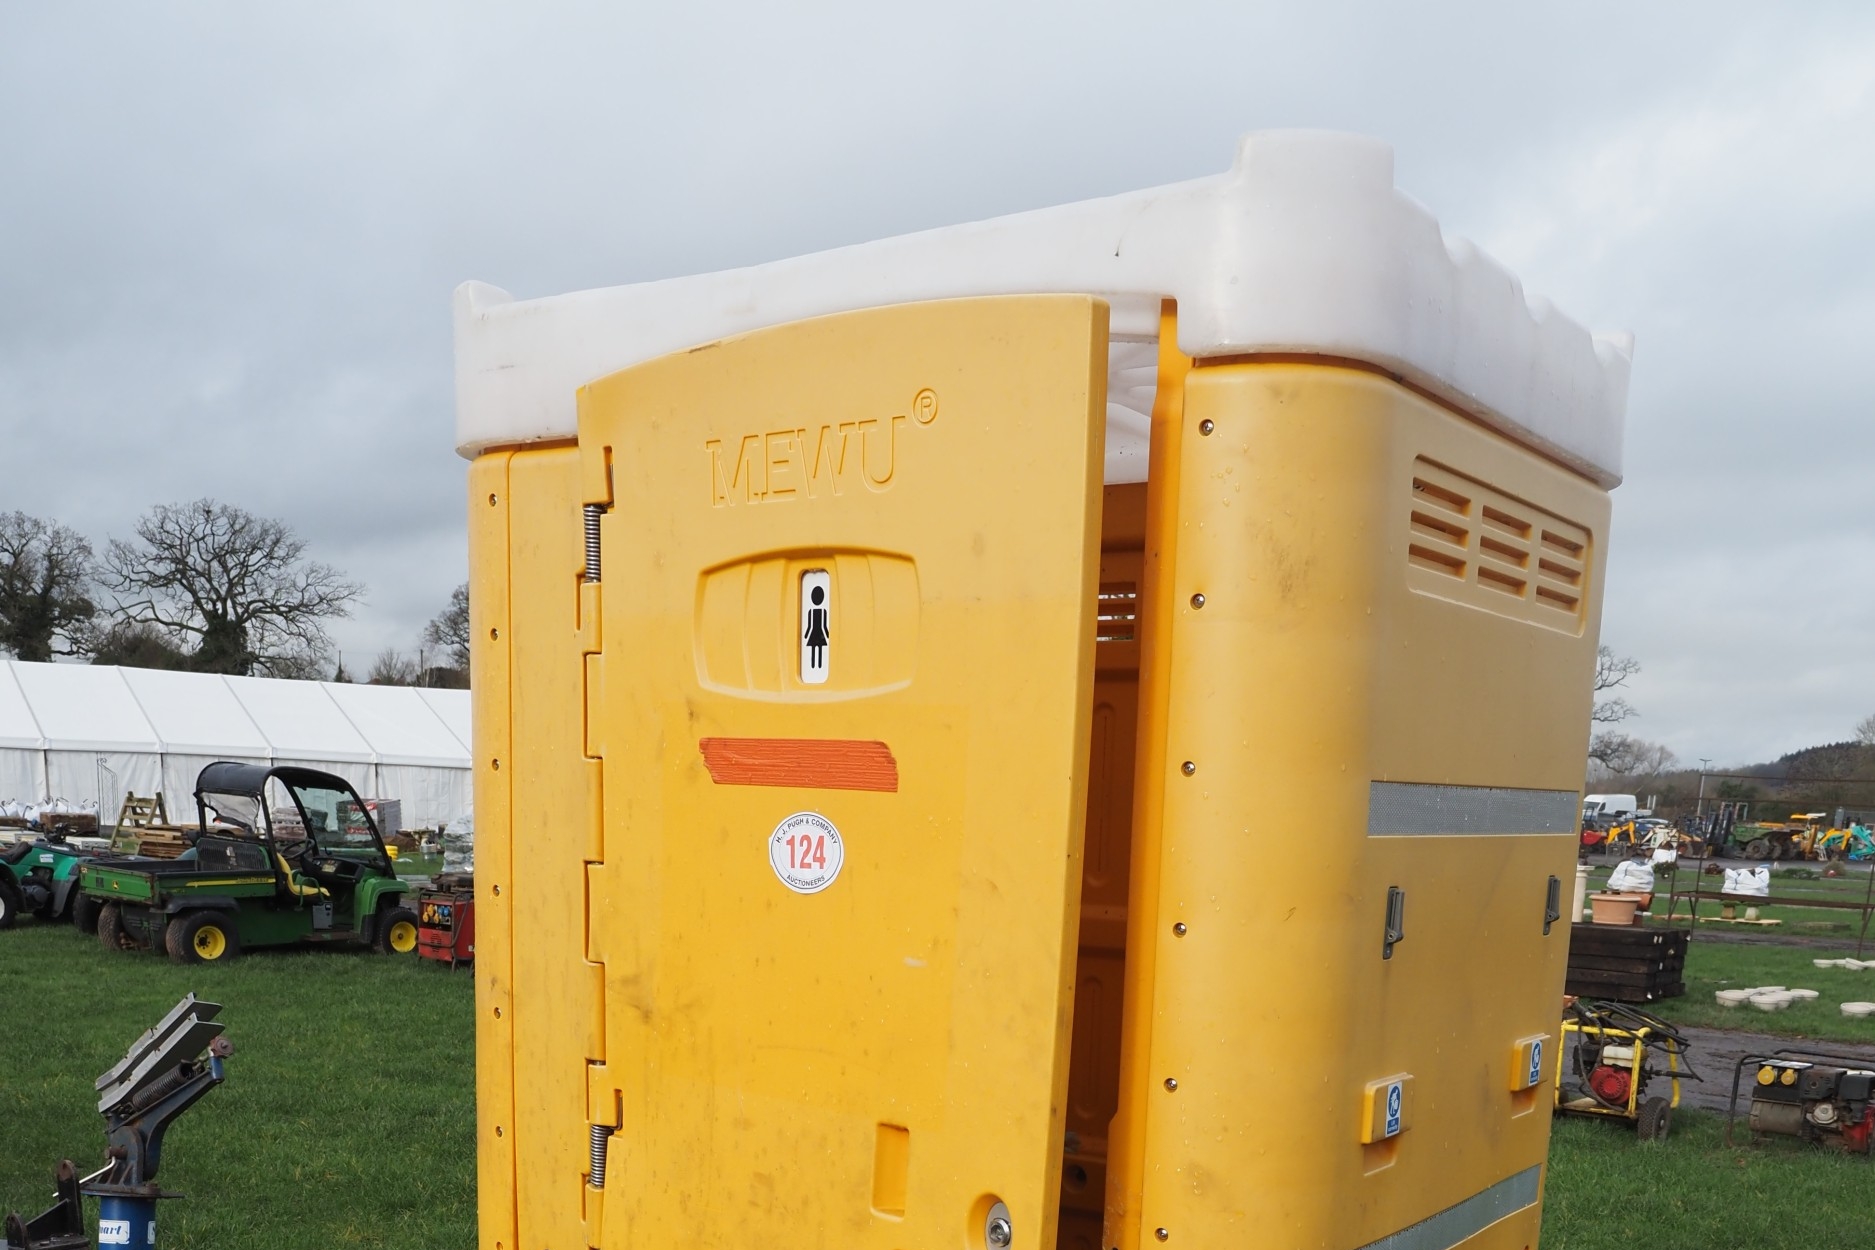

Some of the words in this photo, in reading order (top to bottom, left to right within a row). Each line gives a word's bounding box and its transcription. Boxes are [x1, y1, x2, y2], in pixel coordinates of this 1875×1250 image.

[705, 416, 906, 509] MEWU
[787, 818, 804, 830] PUGH
[805, 817, 810, 825] &
[811, 818, 838, 845] COMPANY
[785, 834, 827, 870] 124
[786, 874, 826, 887] AUCTIONEERS
